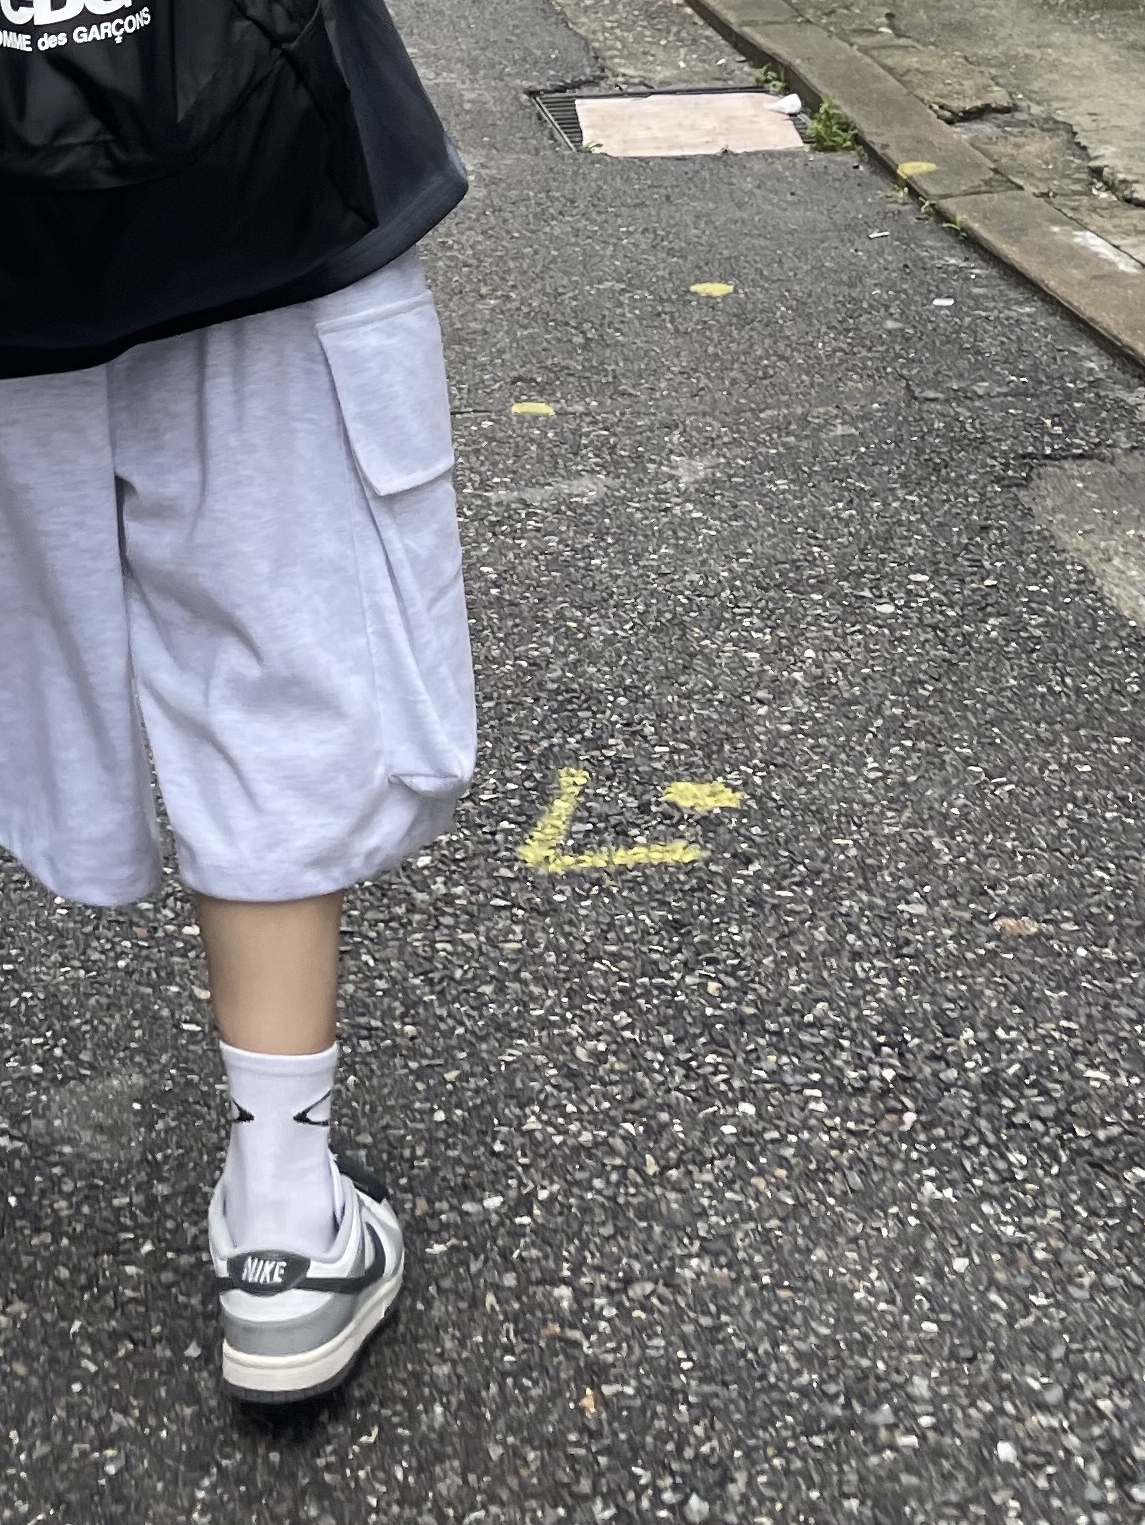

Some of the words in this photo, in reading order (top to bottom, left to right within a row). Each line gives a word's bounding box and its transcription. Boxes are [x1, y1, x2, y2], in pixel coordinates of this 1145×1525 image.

[37, 31, 68, 51] des
[72, 6, 151, 44] GARÇONS
[242, 1256, 288, 1285] NIKE
